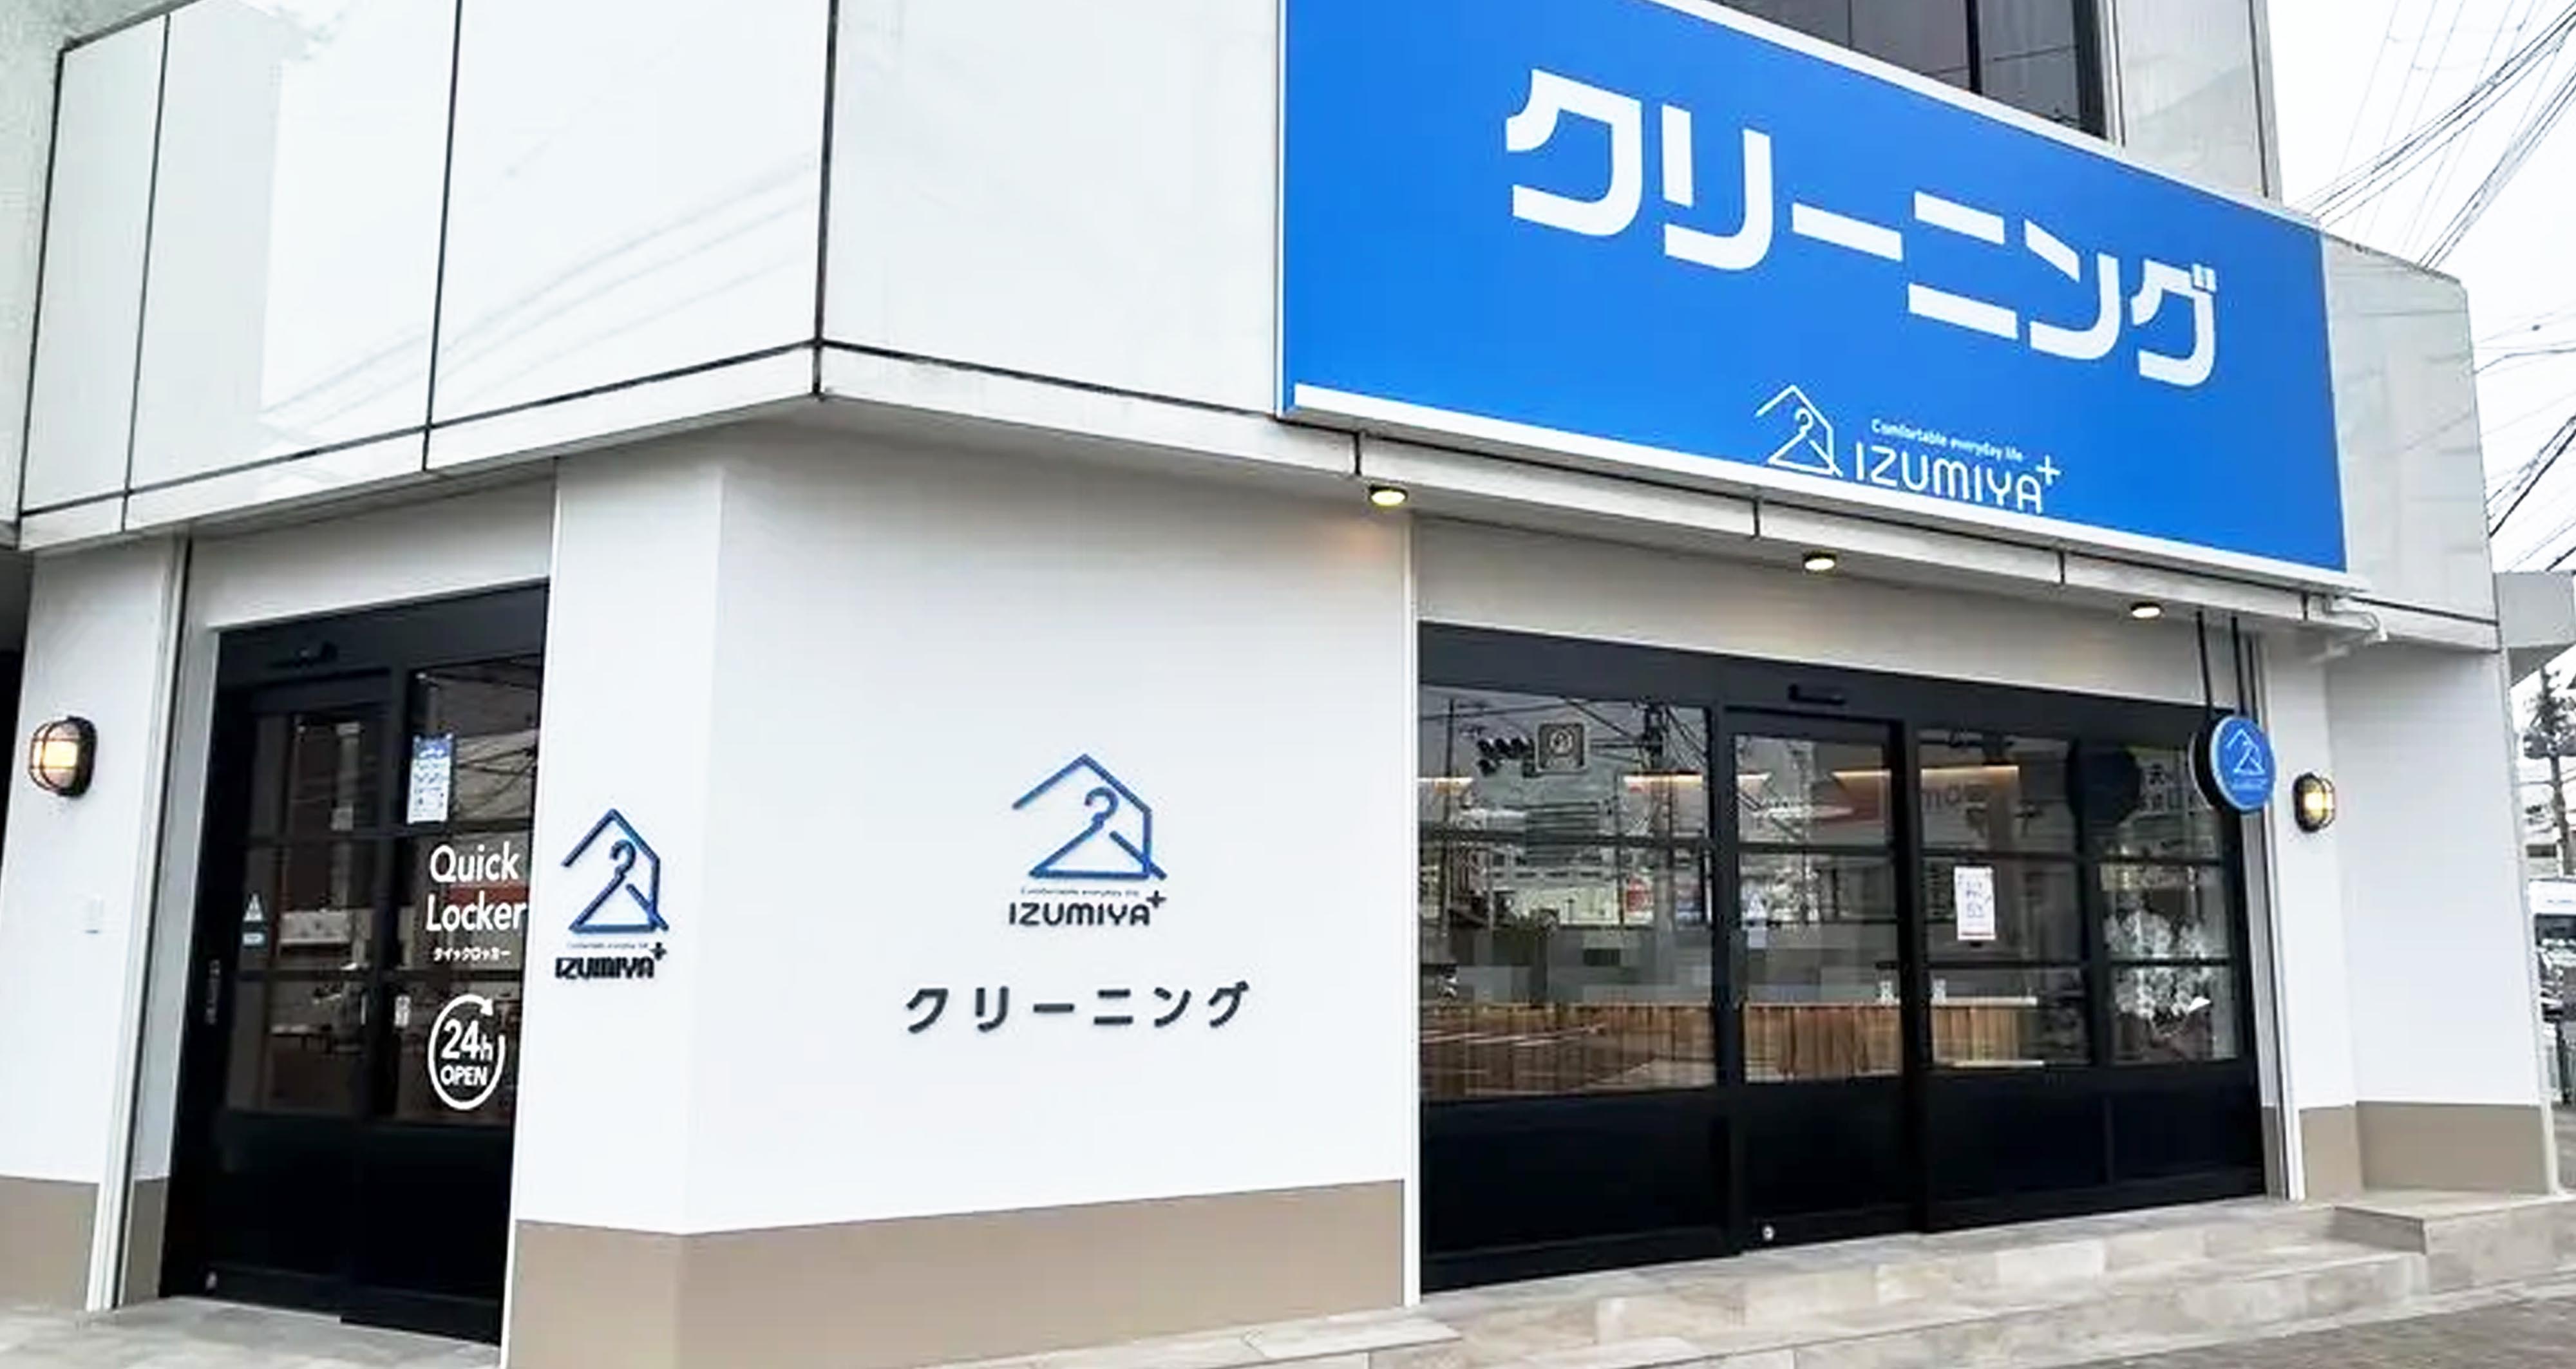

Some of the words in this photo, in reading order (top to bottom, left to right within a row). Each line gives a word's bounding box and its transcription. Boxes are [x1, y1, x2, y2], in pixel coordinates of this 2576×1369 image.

[1505, 68, 2216, 387] クリーニング
[430, 840, 520, 883] Quick
[426, 890, 527, 932] Locker
[905, 980, 1249, 1034] クリーニング
[441, 1018, 493, 1061] 24h
[440, 1064, 488, 1086] OPEN
